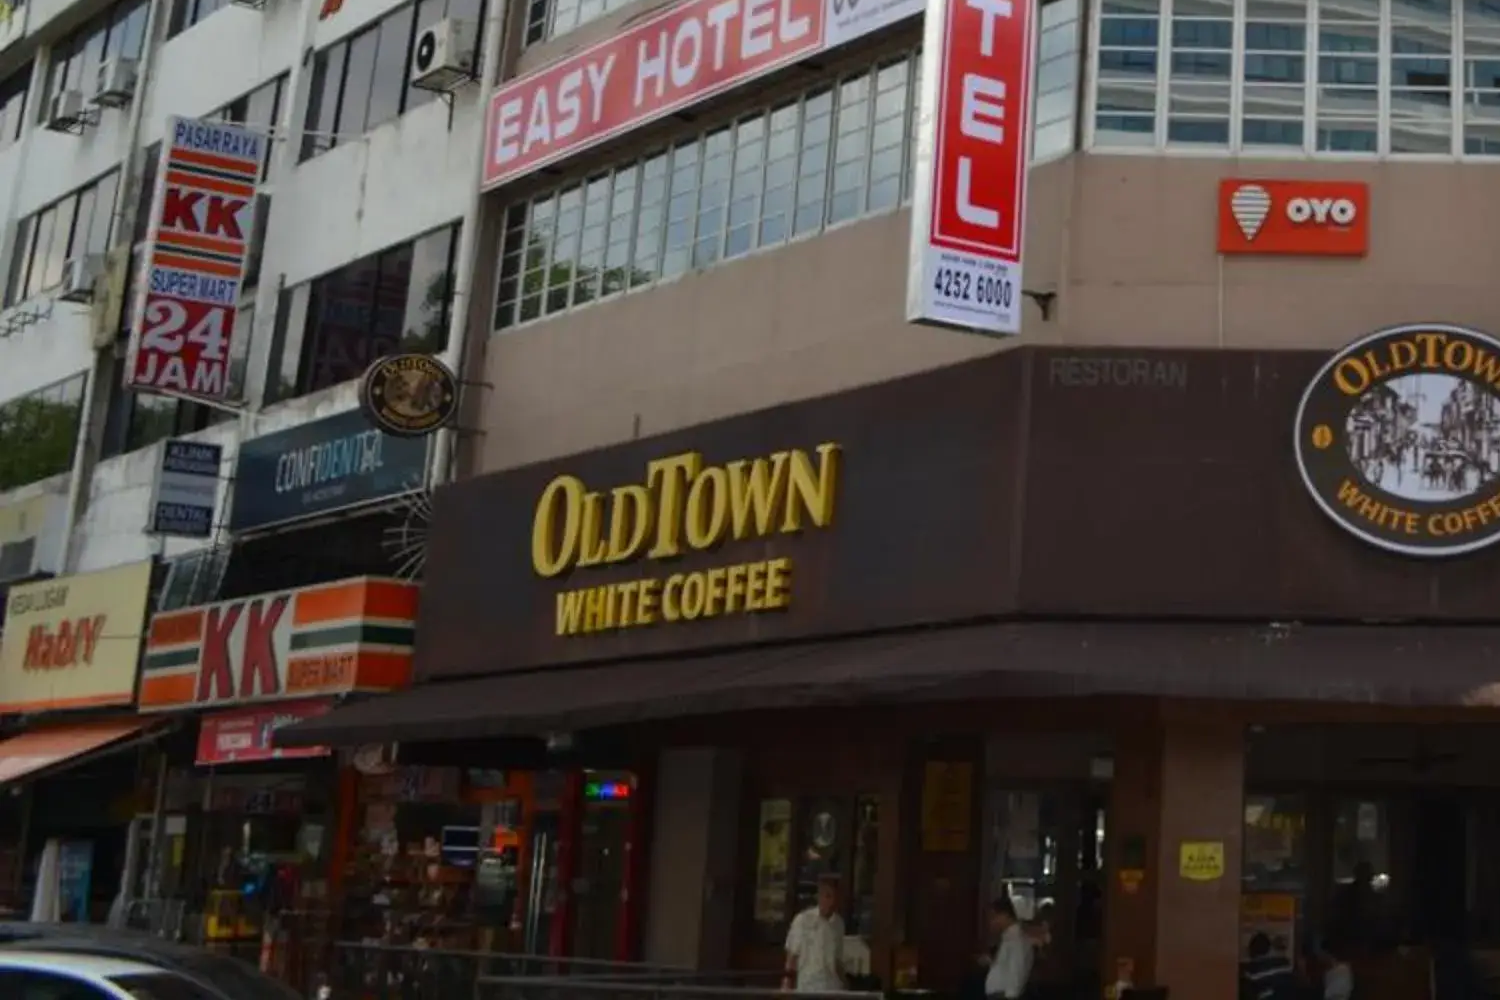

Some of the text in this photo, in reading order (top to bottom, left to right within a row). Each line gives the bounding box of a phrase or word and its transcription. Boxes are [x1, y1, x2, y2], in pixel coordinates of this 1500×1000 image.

[494, 52, 617, 166] EASY
[161, 188, 247, 239] KK
[1285, 197, 1357, 225] OYO
[934, 266, 1012, 309] 4252 6000
[141, 299, 228, 360] 24
[135, 353, 223, 394] JAM
[1050, 356, 1188, 388] RESTORAN
[532, 440, 843, 579] OLDTOWN
[1337, 479, 1420, 534] WHITE
[556, 556, 793, 636] WHITE COFFEE
[199, 592, 292, 703] KK
